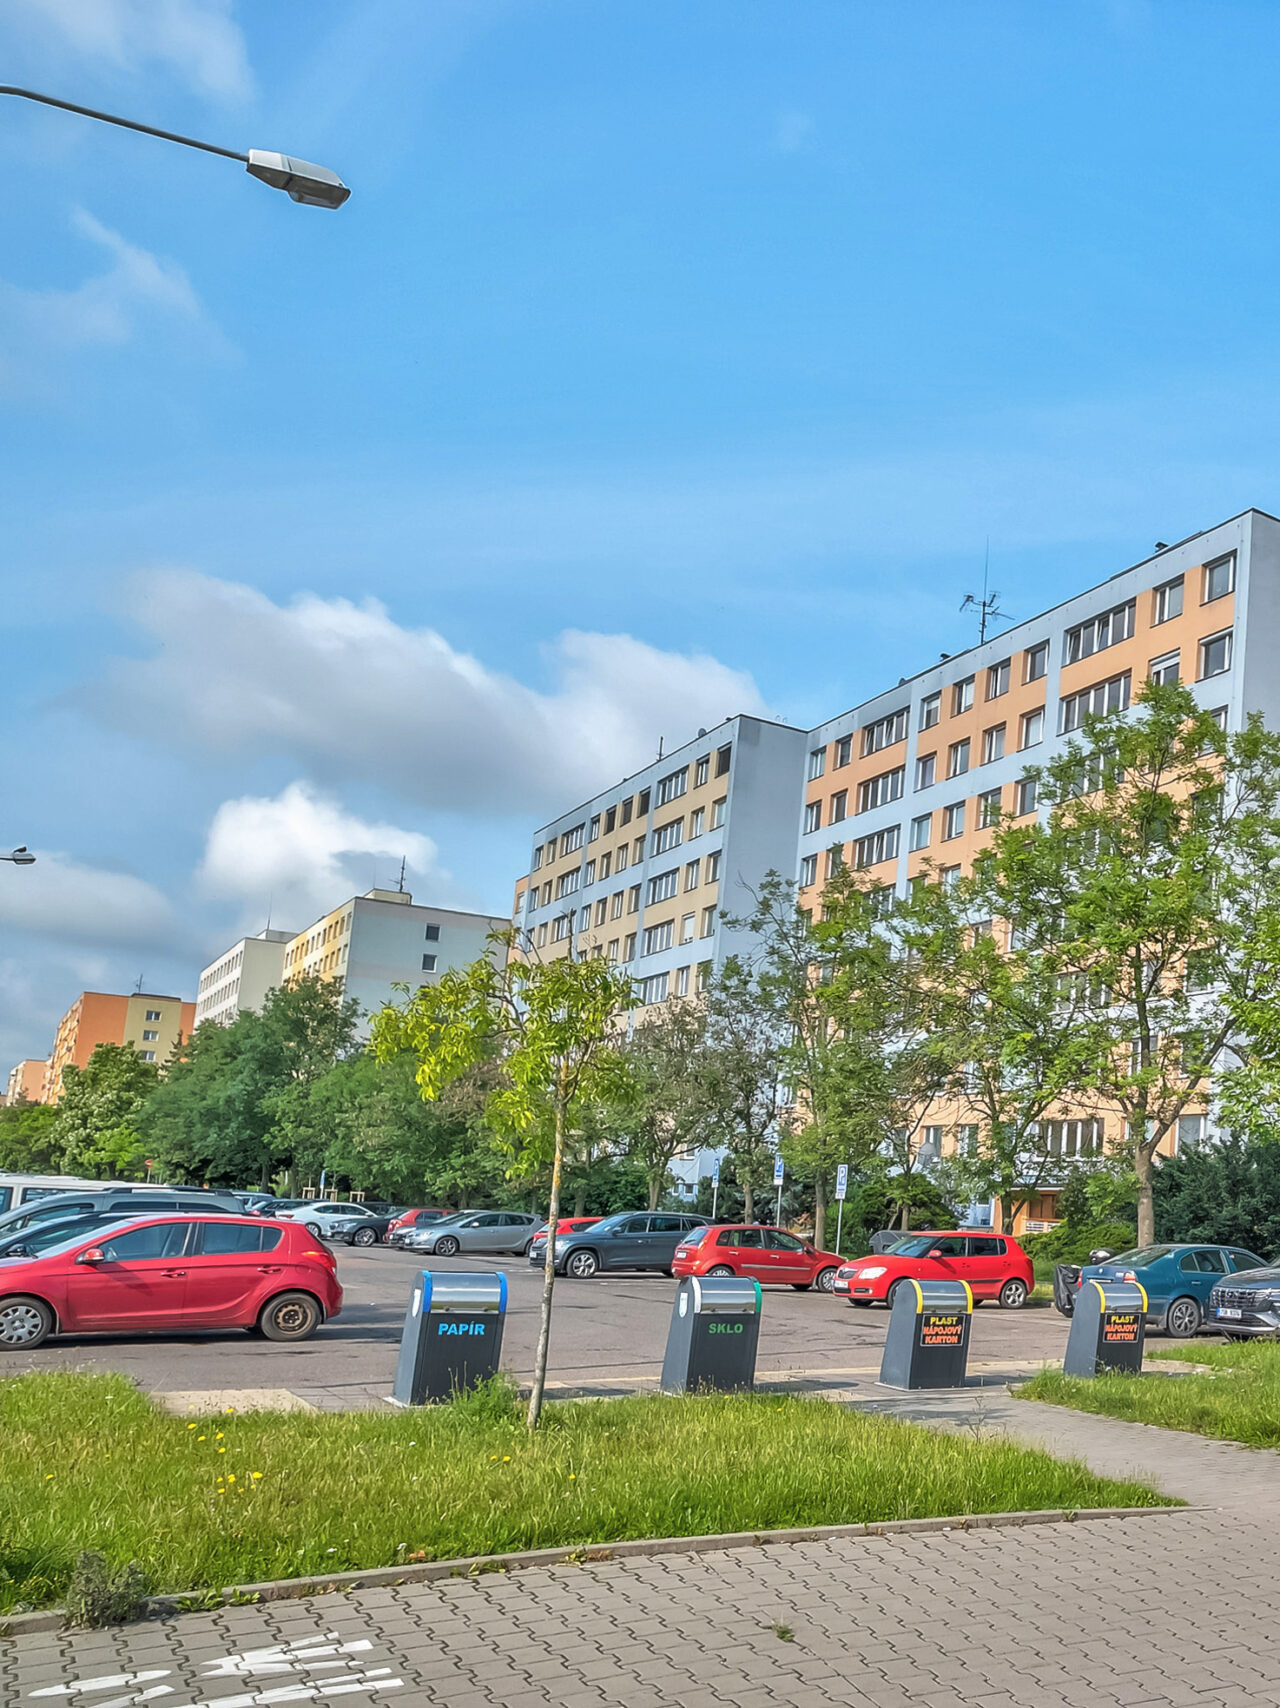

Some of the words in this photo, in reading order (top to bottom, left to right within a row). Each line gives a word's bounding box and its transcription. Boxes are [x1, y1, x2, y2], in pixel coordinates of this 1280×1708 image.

[840, 1167, 846, 1182] P
[930, 1316, 958, 1325] PLAST
[1111, 1315, 1134, 1323] PLAST
[438, 1320, 485, 1336] PAPÍR
[708, 1322, 744, 1334] SKLO
[923, 1325, 962, 1335] NÁPOJOVÝ
[925, 1335, 958, 1344] KARTON
[1107, 1332, 1135, 1341] KARTON
